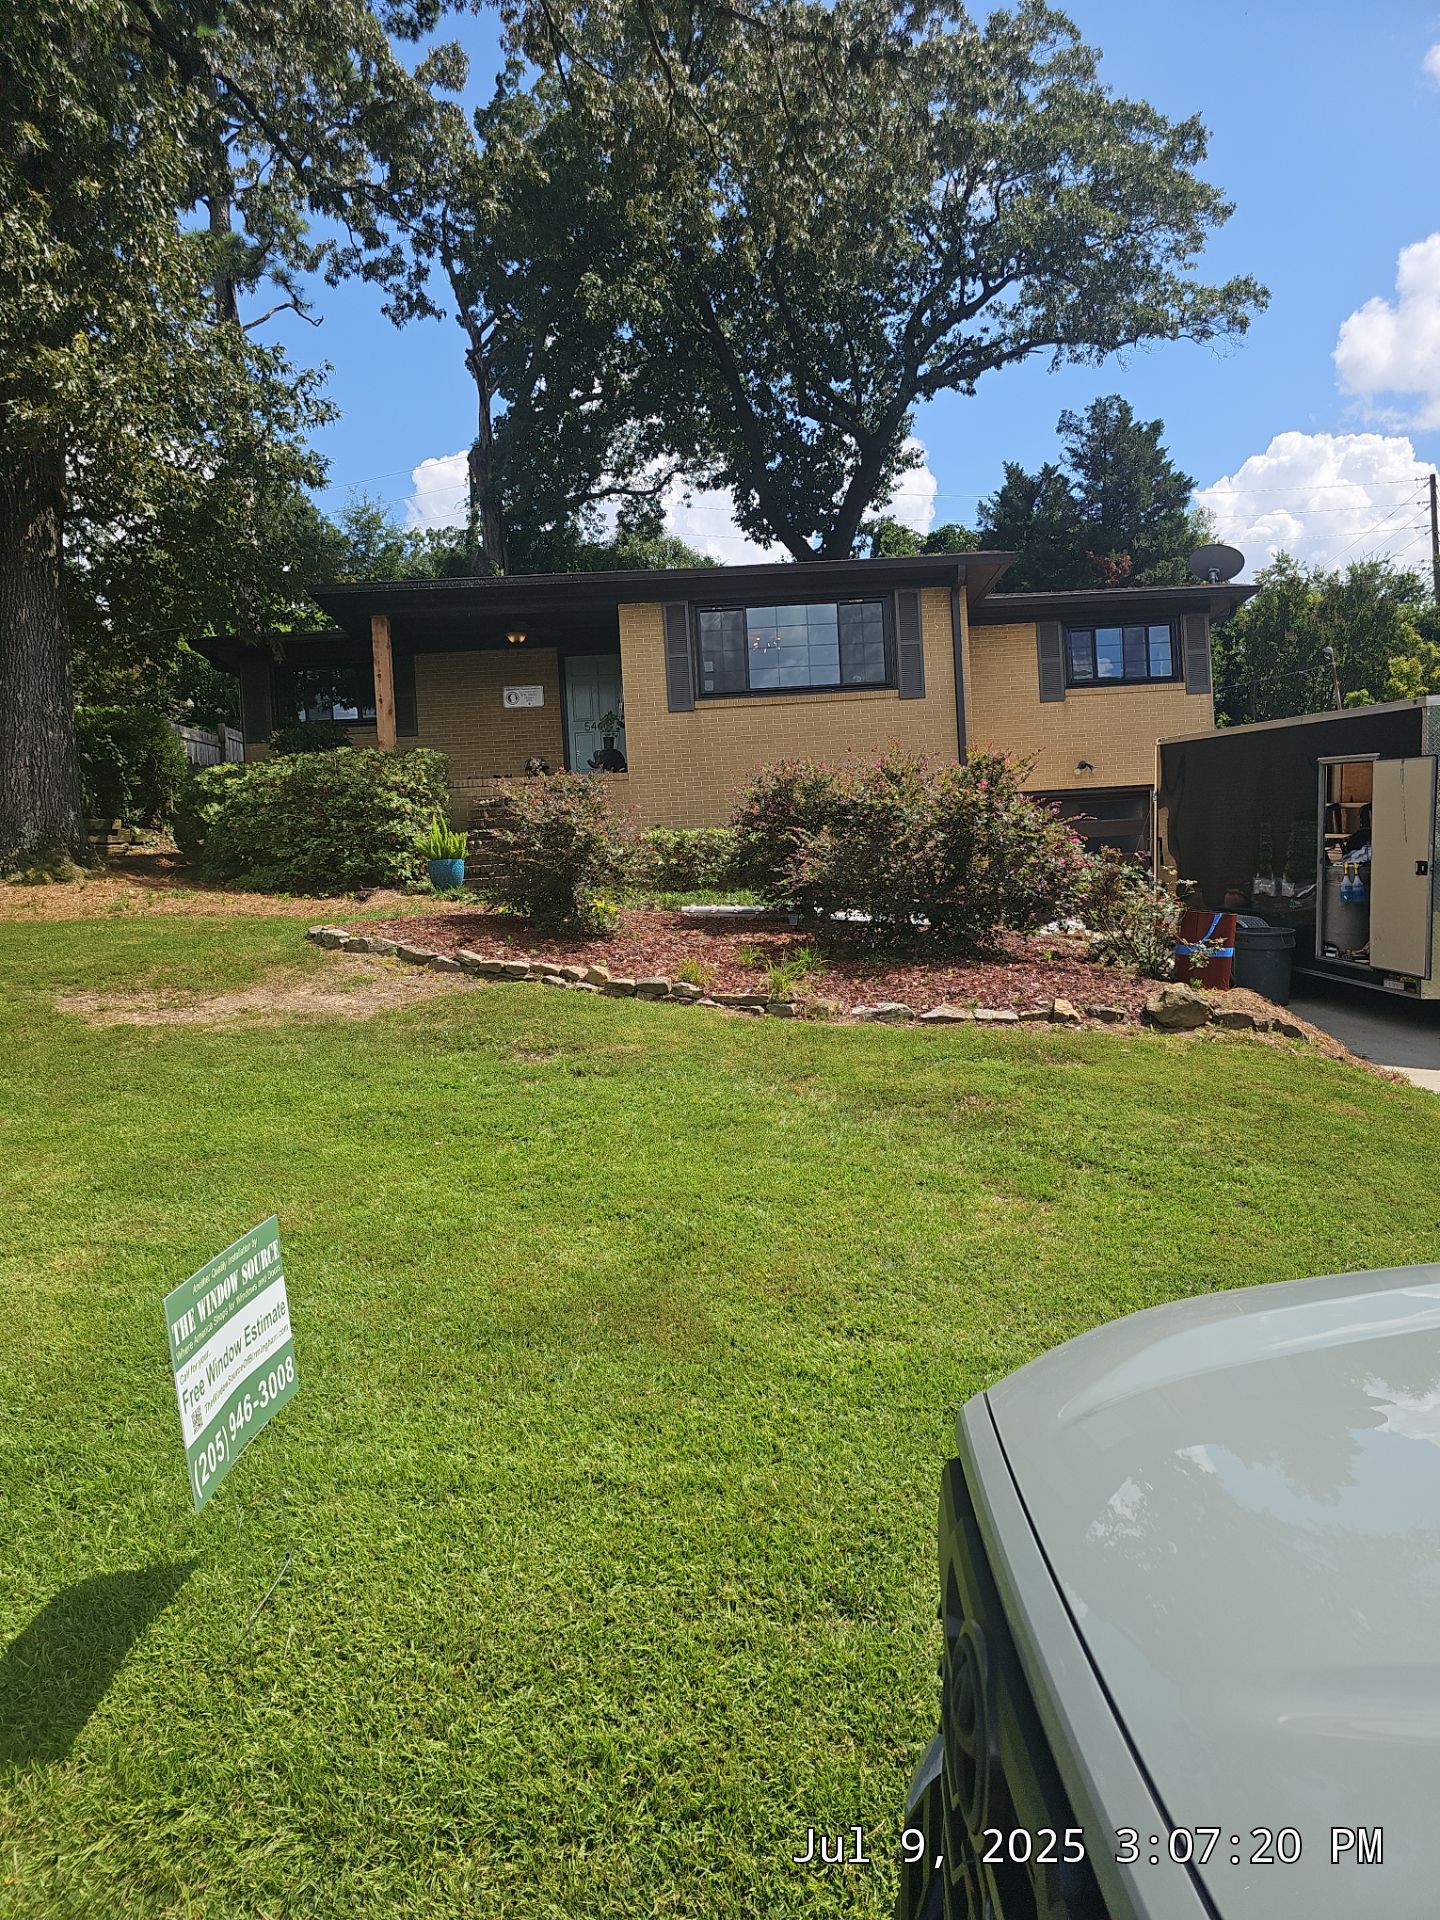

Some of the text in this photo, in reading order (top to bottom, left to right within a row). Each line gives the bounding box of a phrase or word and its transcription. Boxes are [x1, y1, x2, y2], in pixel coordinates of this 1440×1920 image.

[251, 1237, 257, 1249] by
[171, 1239, 280, 1347] THE WINDOW SOURCE
[175, 1341, 194, 1362] Where
[213, 1307, 229, 1326] Shops
[228, 1301, 236, 1312] for
[257, 1274, 267, 1288] and
[180, 1367, 190, 1386] Call
[190, 1360, 198, 1375] for
[182, 1301, 286, 1414] Free Window Estimate
[194, 1355, 295, 1499] (205) 946-3008
